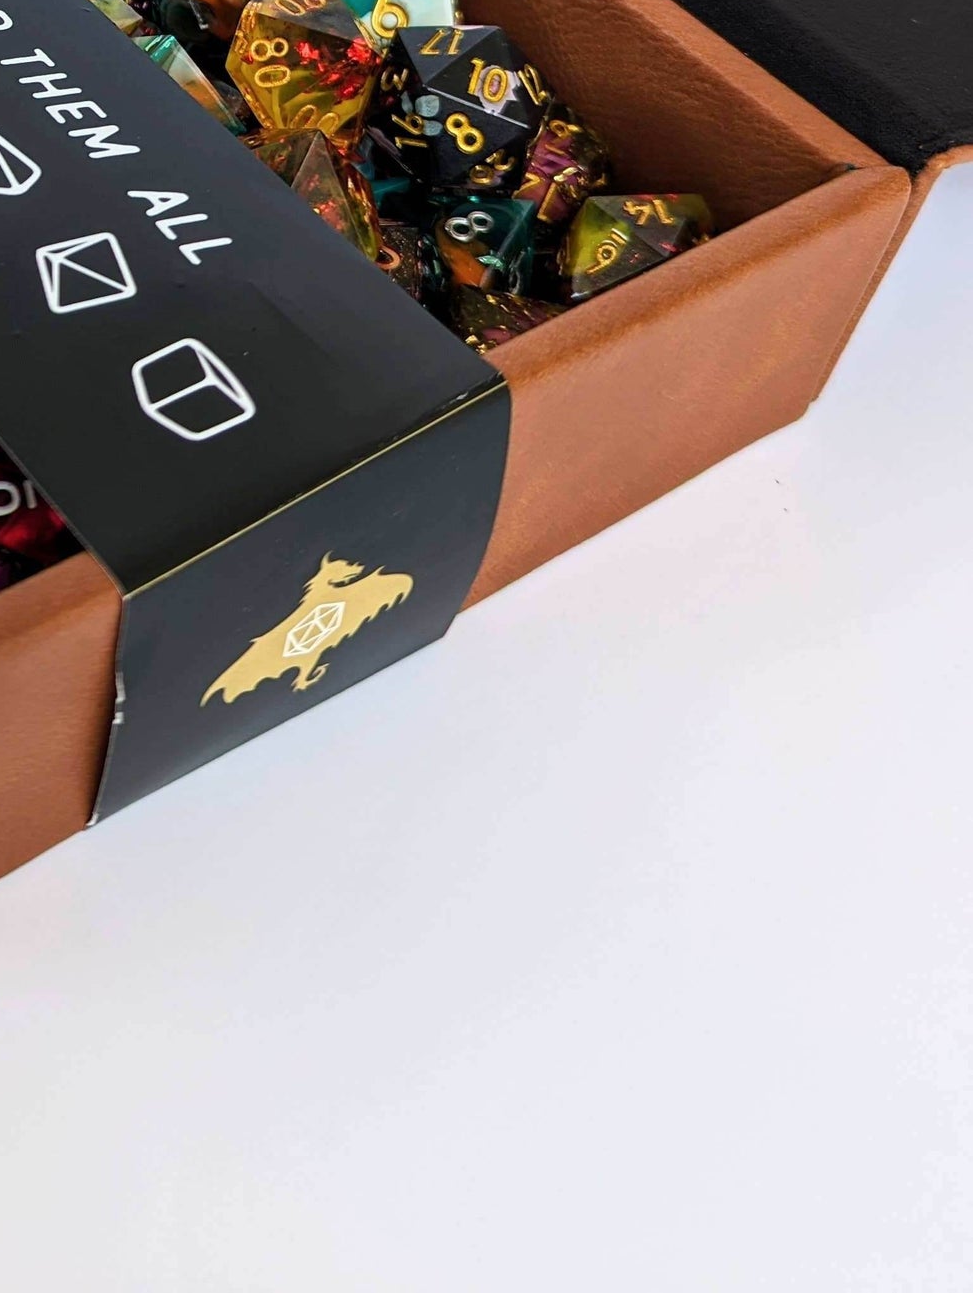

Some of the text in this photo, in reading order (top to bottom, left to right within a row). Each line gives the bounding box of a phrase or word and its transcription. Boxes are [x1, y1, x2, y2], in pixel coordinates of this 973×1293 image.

[250, 37, 291, 88] 80
[467, 58, 508, 103] 10
[391, 113, 428, 149] 16
[444, 112, 485, 154] 8
[0, 48, 140, 159] THEM
[127, 190, 232, 265] ALL
[444, 210, 494, 243] 8
